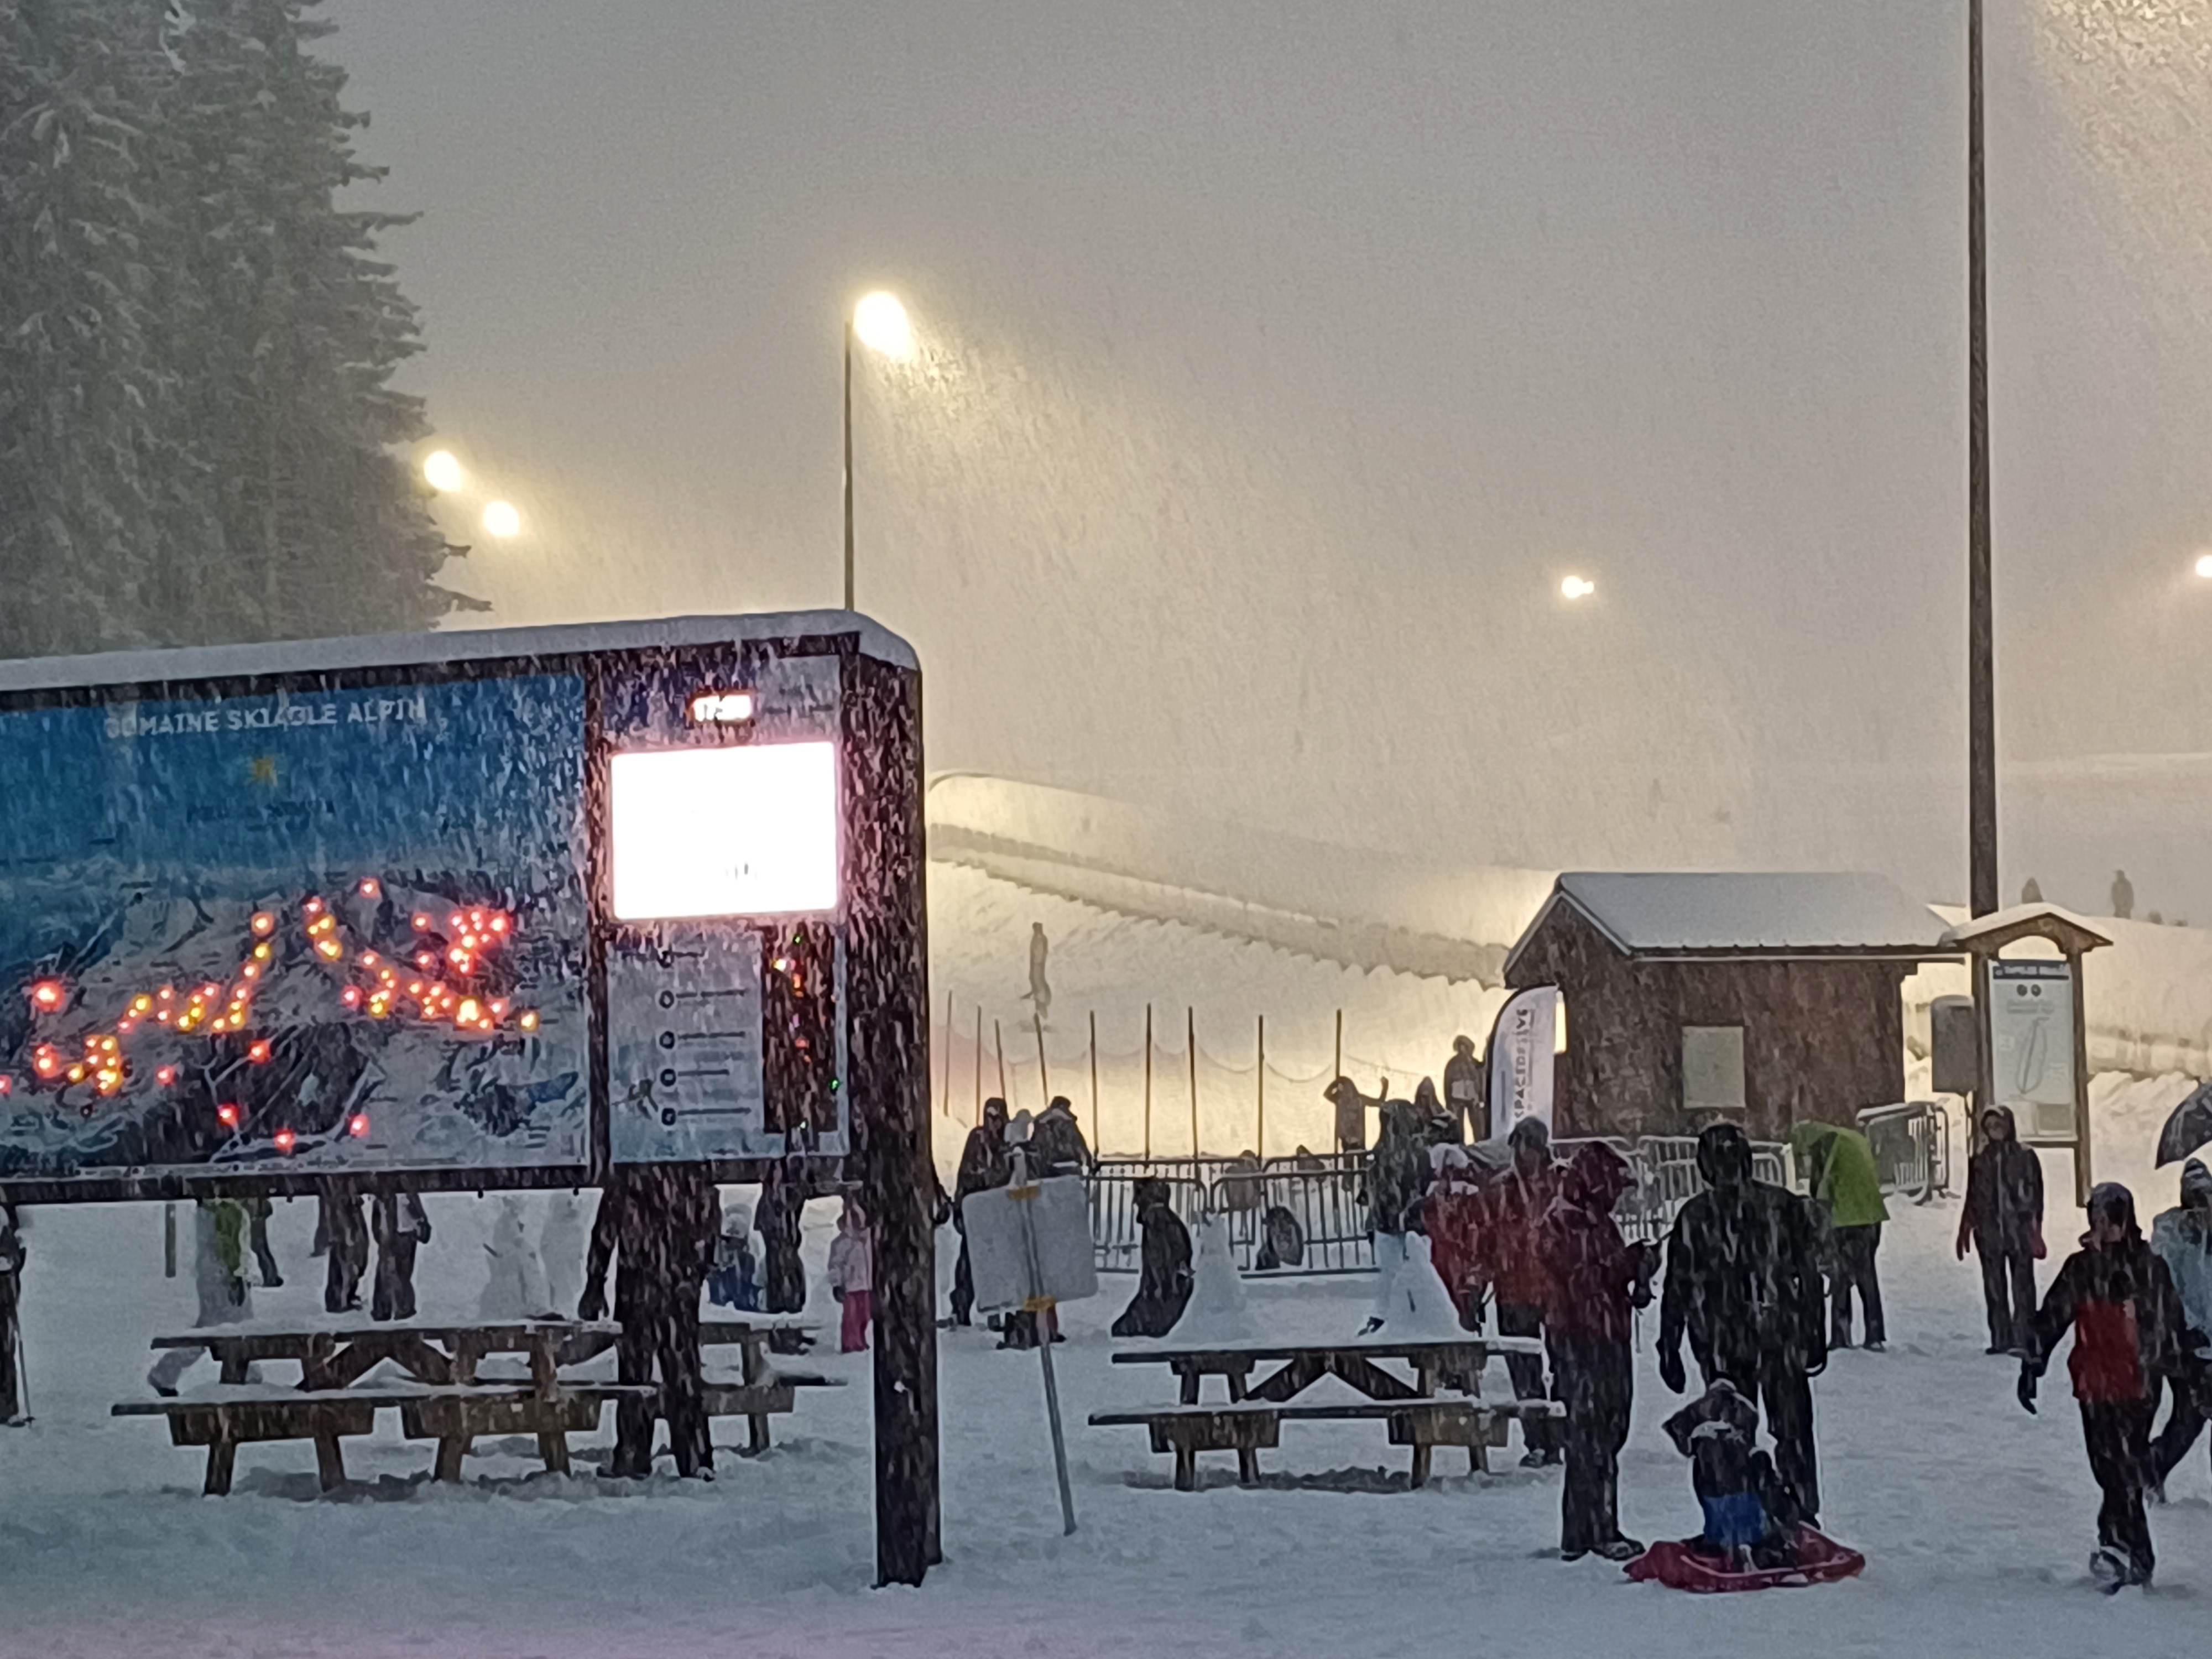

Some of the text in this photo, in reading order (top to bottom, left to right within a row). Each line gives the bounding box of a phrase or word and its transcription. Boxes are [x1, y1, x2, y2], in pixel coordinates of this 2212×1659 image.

[105, 698, 427, 738] DOMAINE SKIABLE ALPIN
